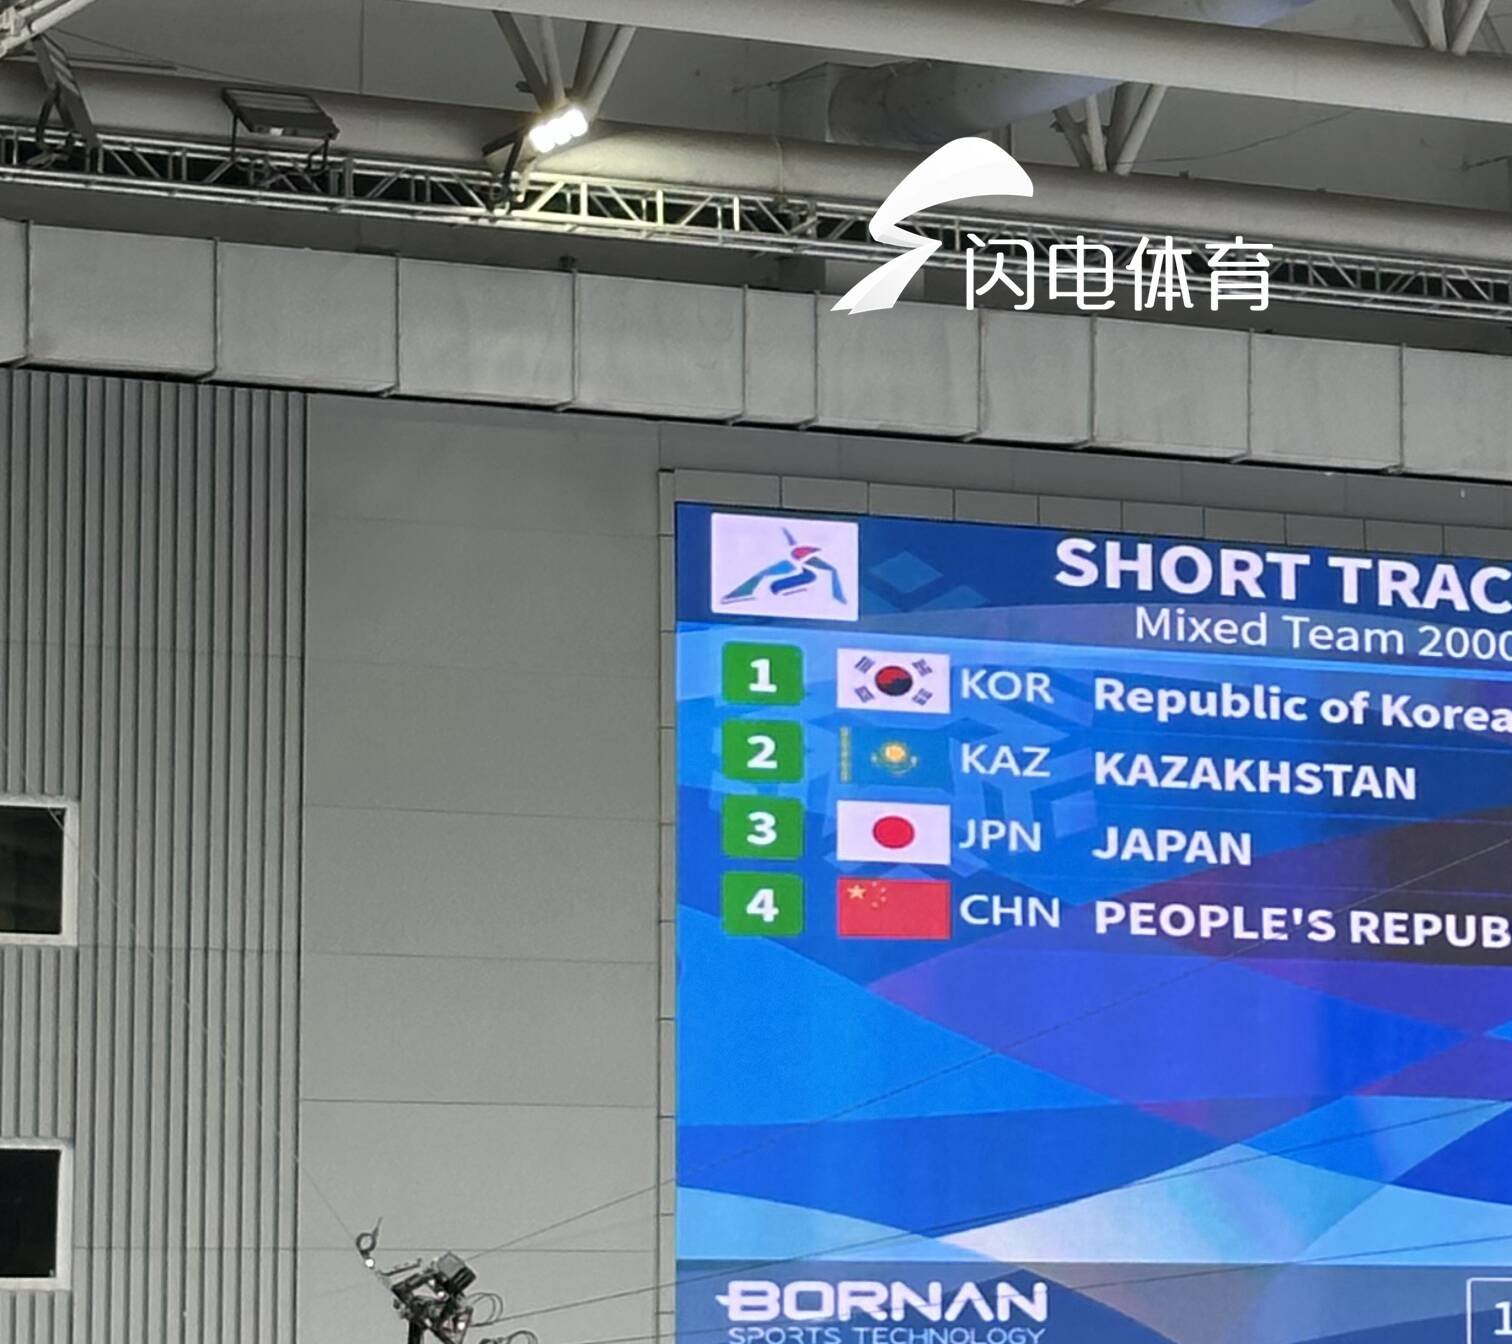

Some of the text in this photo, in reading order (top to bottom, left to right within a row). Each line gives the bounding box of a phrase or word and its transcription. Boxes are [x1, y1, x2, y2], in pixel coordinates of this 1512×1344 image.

[1055, 537, 1311, 601] SHORT
[1136, 606, 1267, 646] Mixed
[1281, 615, 1404, 655] Team
[749, 658, 777, 693] 1
[961, 668, 1054, 704] KOR
[1095, 677, 1308, 722] Republic
[1320, 690, 1371, 725] of
[747, 735, 778, 769] 2
[962, 743, 1051, 777] KAZ
[1095, 751, 1416, 800] KAZAKHSTAN
[747, 811, 777, 846] 3
[959, 819, 1041, 852] JPN
[1092, 826, 1252, 866] JAPAN
[746, 888, 779, 922] 4
[959, 894, 1060, 928] CHN
[1095, 901, 1336, 942] PEOPLE'S
[715, 1280, 1048, 1322] BORNAN
